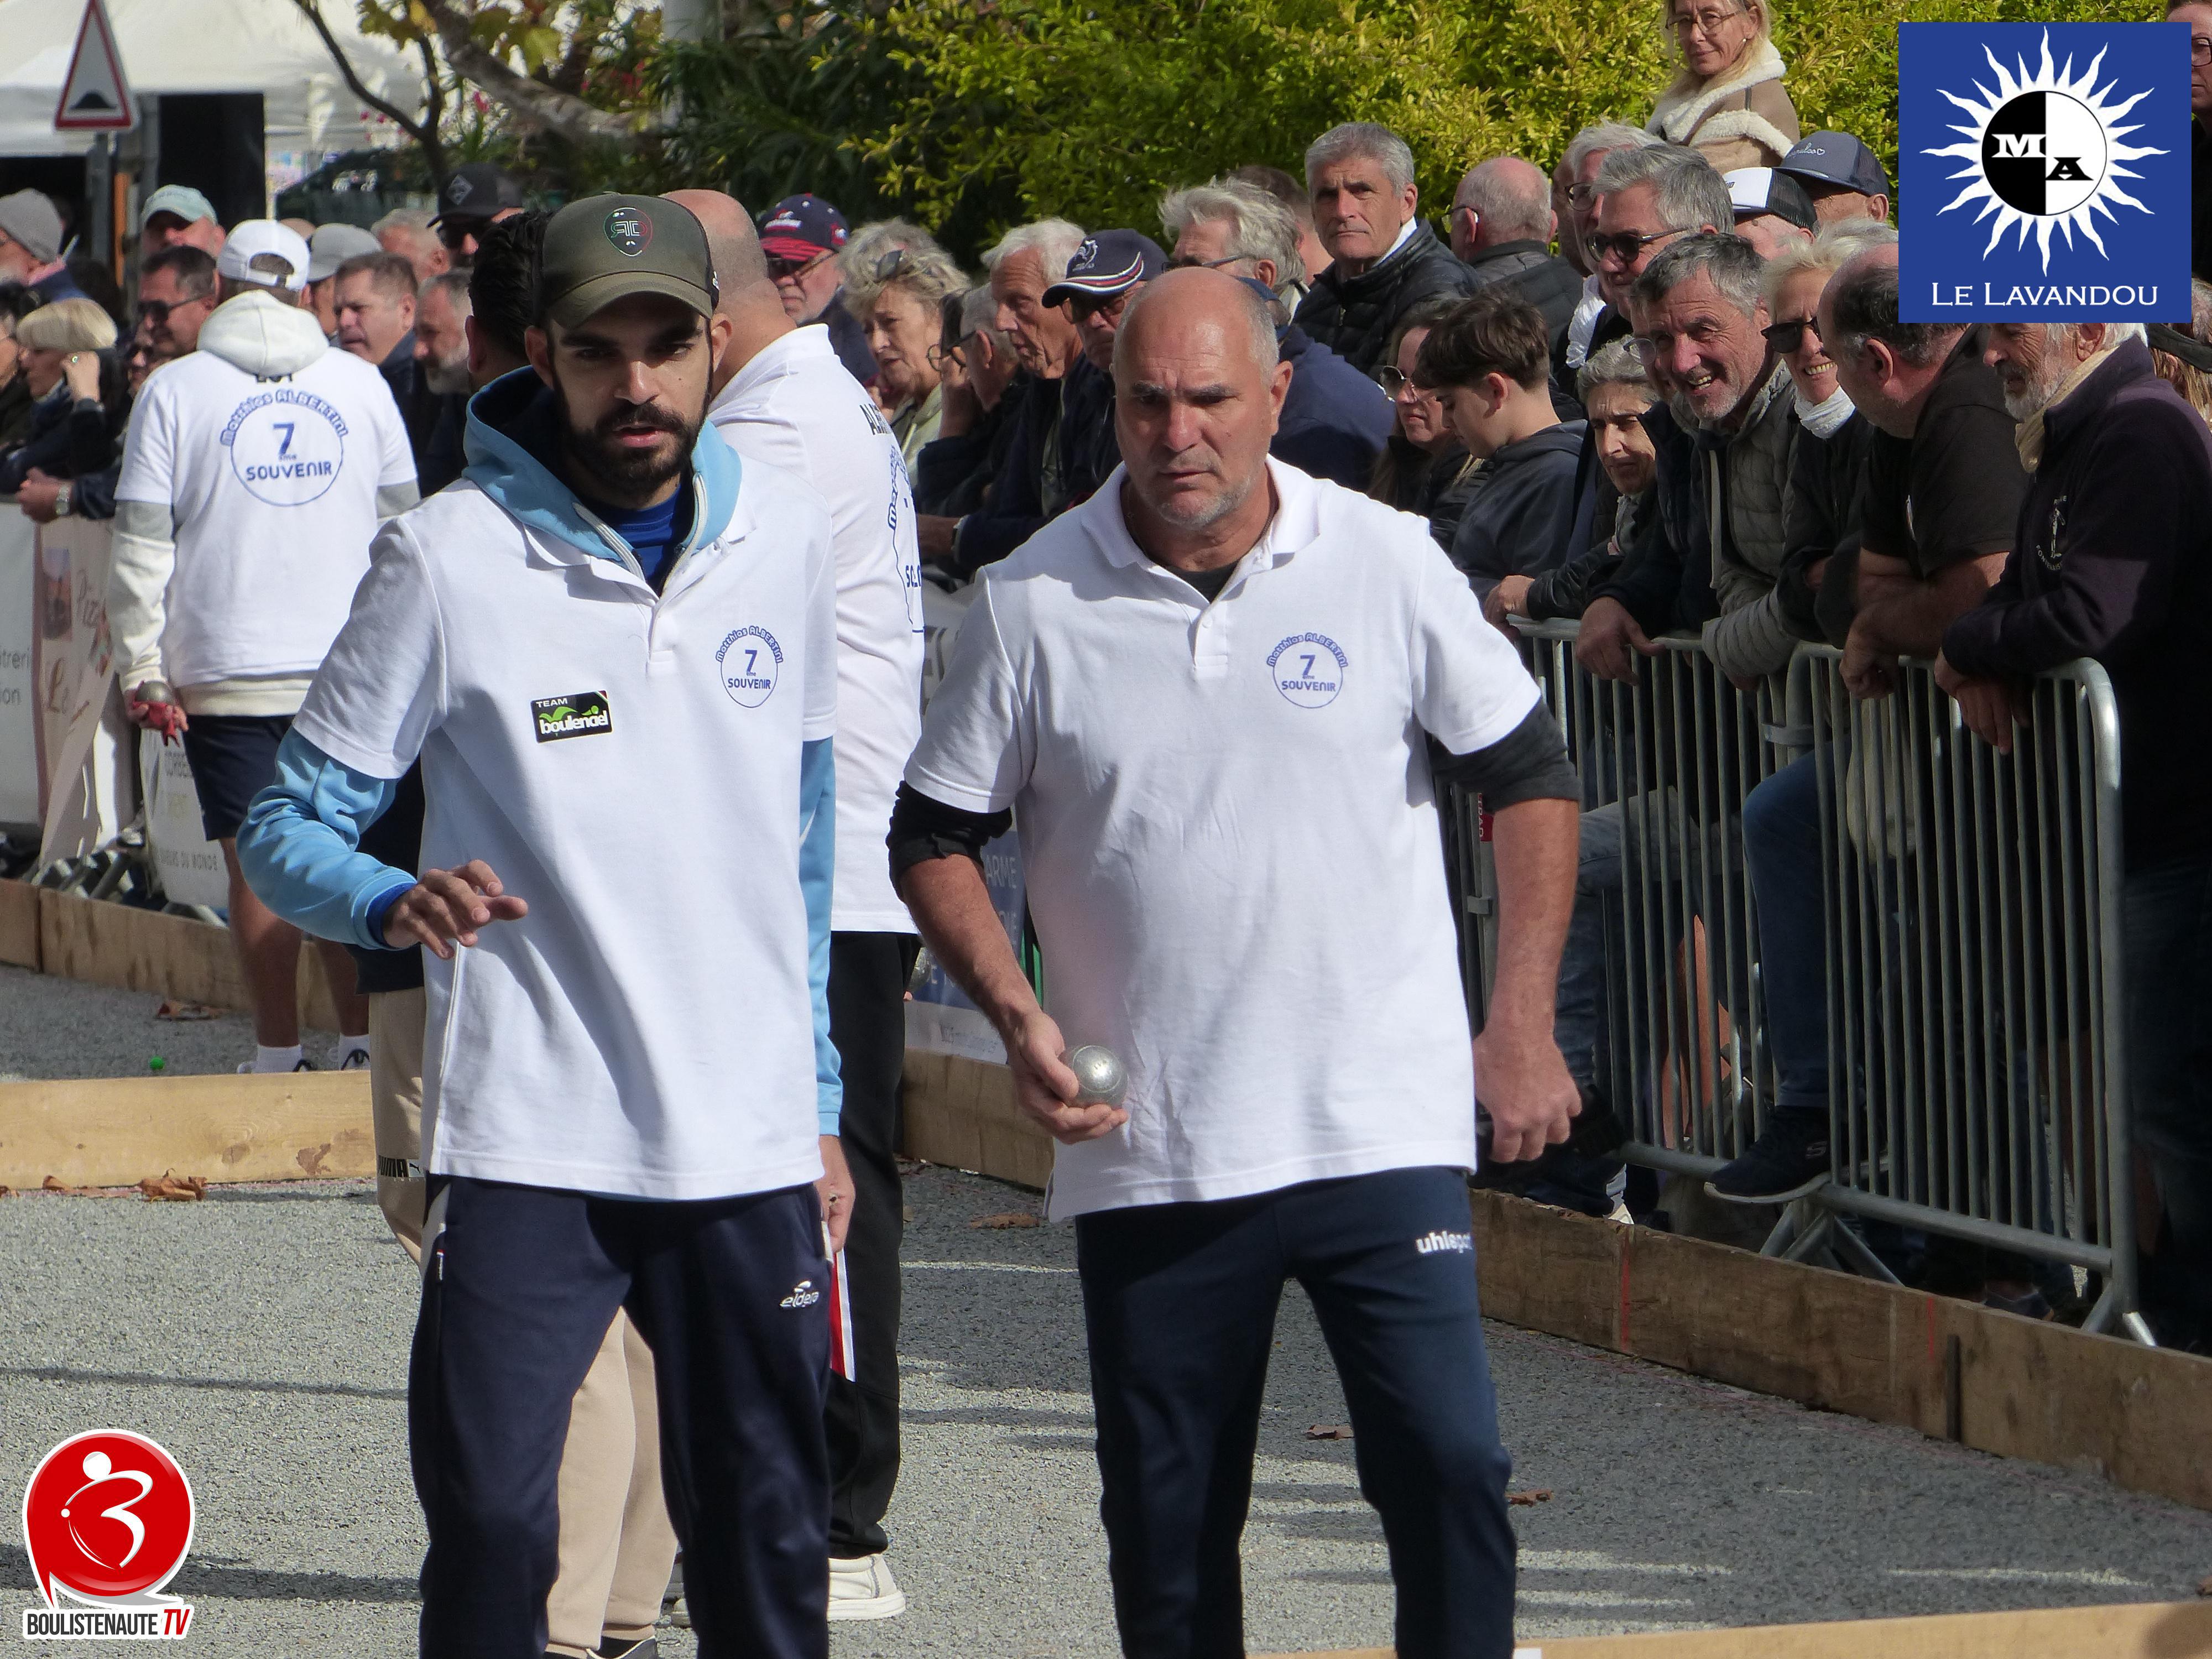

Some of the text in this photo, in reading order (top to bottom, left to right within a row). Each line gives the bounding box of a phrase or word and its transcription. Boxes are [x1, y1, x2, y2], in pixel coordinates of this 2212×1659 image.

[273, 423, 295, 455] 7
[247, 461, 332, 481] SOUVENIR
[749, 625, 784, 664] ALBERTINI
[1305, 632, 1349, 668] ALBERTINI
[745, 649, 758, 672] 7
[1300, 654, 1316, 676] 7
[728, 678, 771, 690] SOUVENIR
[1281, 680, 1336, 692] SOUVENIR
[536, 698, 567, 708] TEAM
